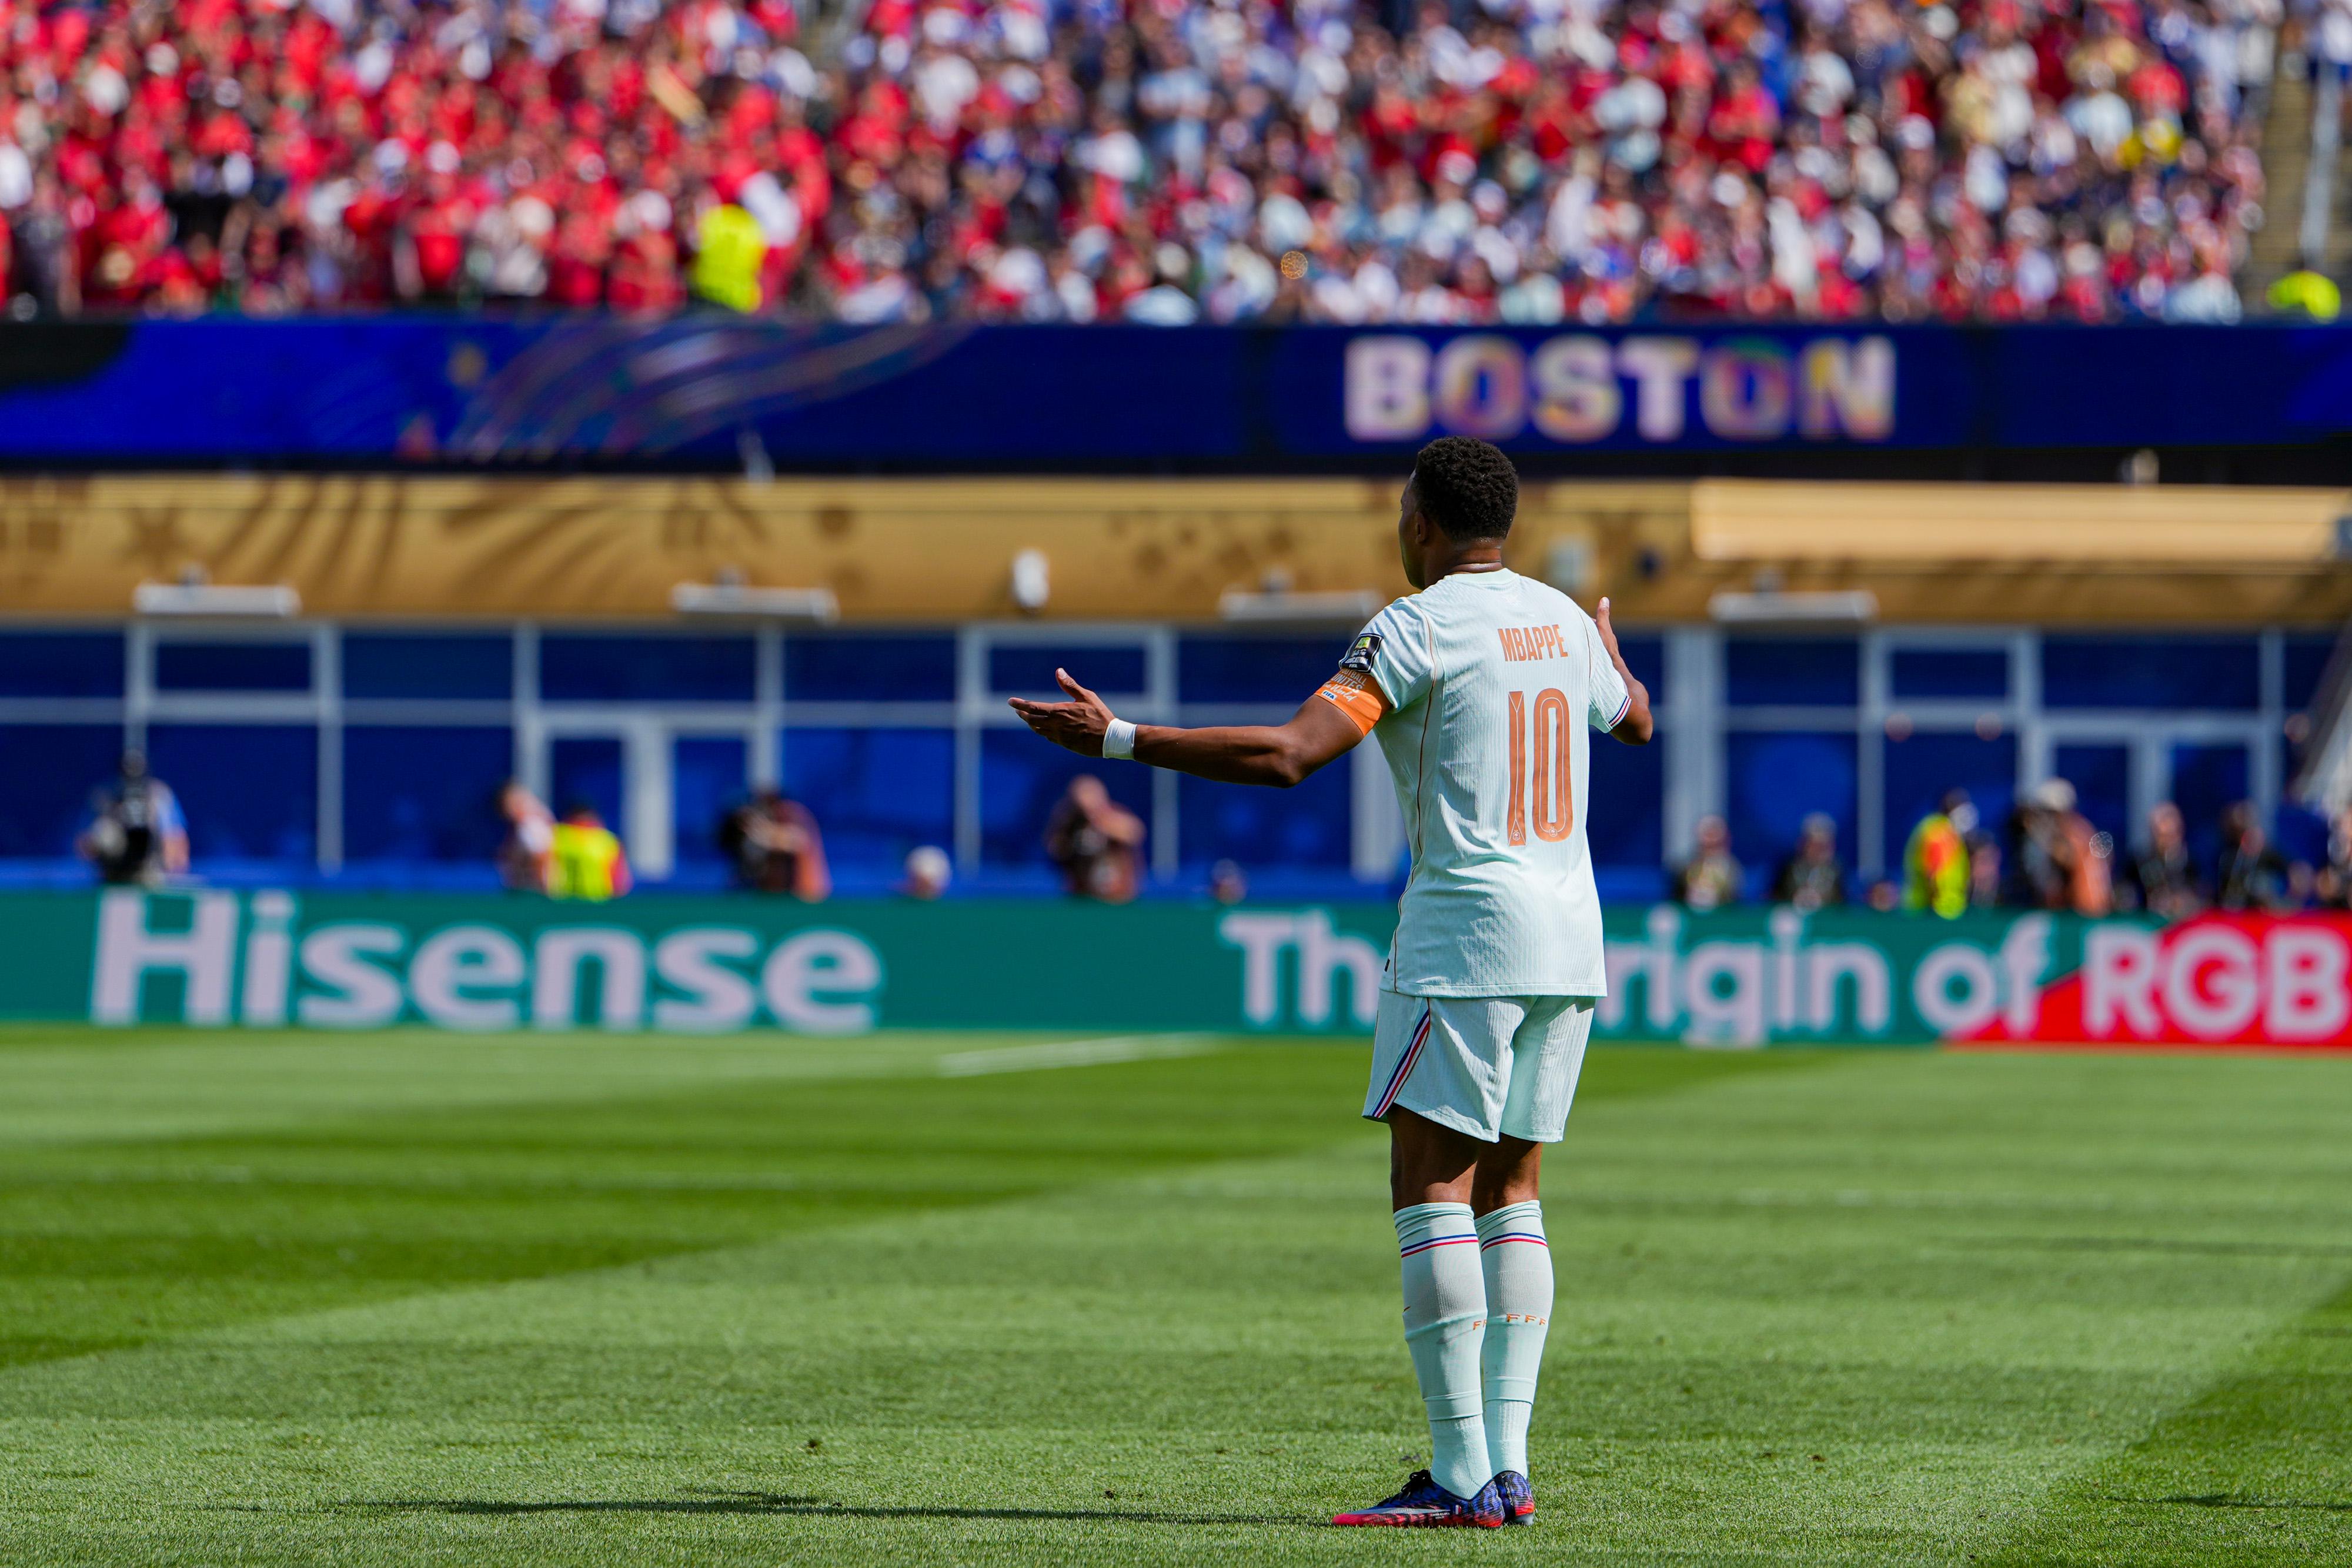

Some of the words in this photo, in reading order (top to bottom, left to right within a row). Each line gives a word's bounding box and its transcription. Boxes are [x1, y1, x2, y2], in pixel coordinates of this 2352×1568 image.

[1343, 335, 1896, 441] BOSTON
[1498, 624, 1568, 661] MBAPPE
[1322, 691, 1335, 700] FIFA
[1331, 673, 1363, 693] UNITES
[1508, 688, 1573, 846] 10
[90, 888, 884, 1034] Hisense
[1220, 910, 1382, 1024] Th
[1595, 904, 1891, 1049] rigin
[1913, 911, 2053, 1038] of
[2083, 922, 2350, 1042] RGB
[1506, 1313, 1546, 1325] FFF
